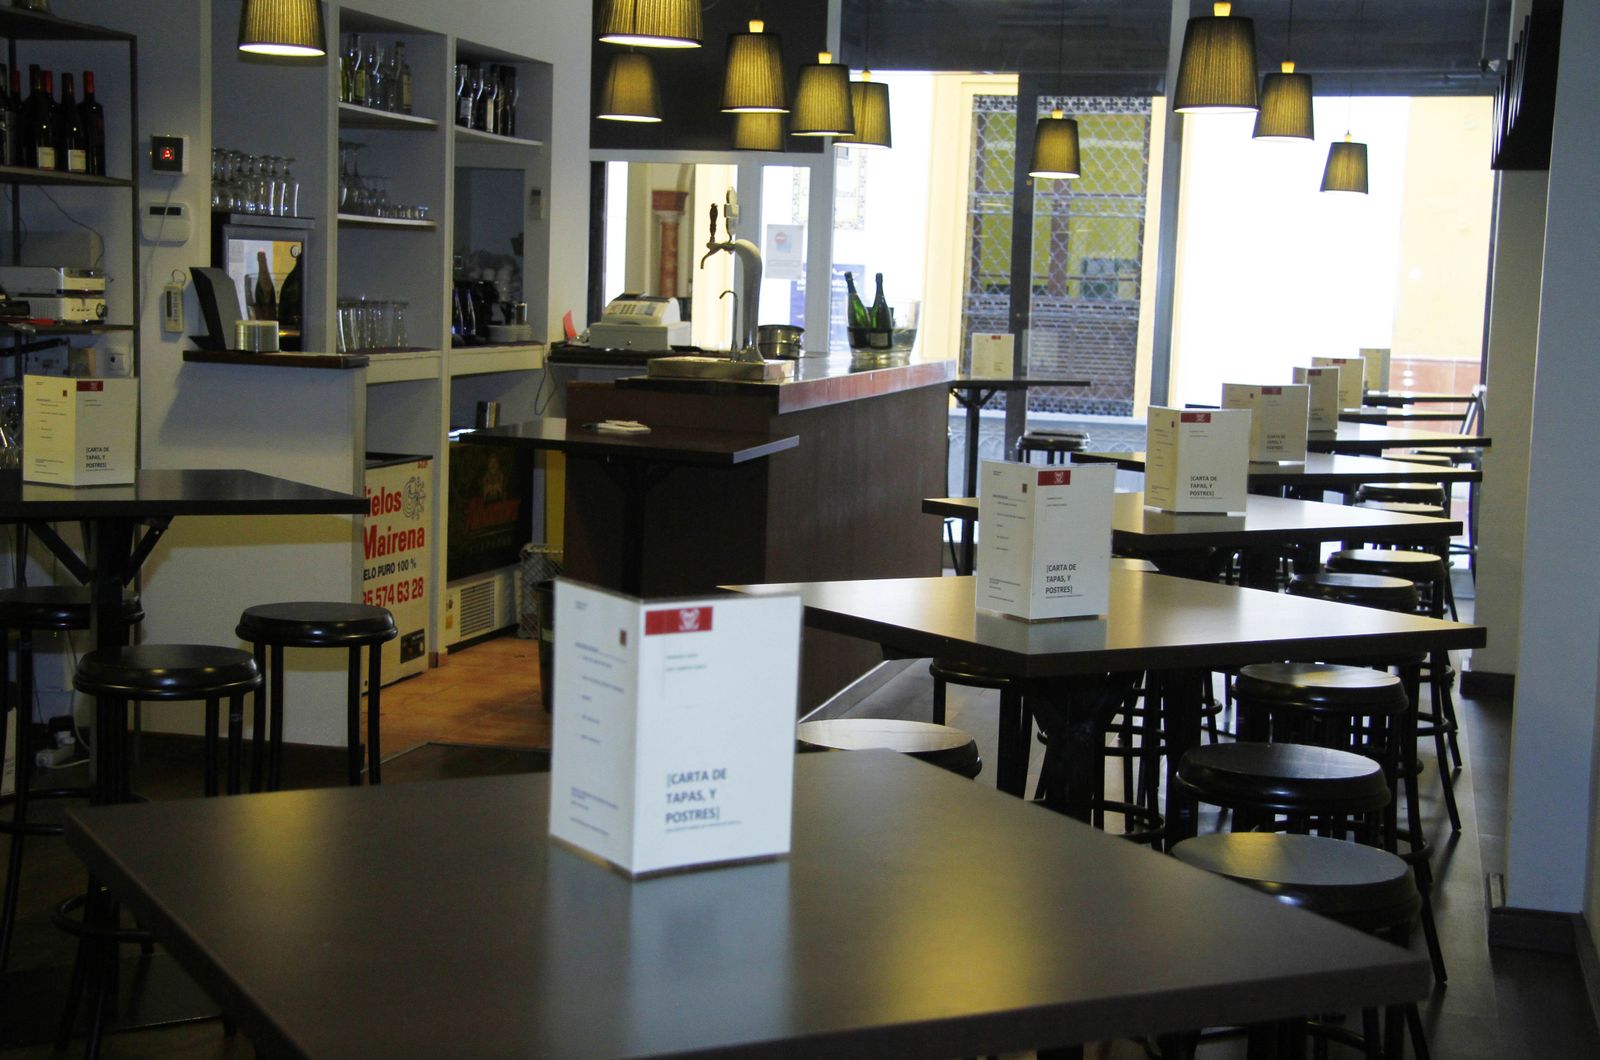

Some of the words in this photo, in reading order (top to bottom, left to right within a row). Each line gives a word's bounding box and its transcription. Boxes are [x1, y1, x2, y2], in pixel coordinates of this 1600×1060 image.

[363, 525, 425, 561] Mairena
[363, 567, 376, 580] ELO
[378, 562, 395, 578] PURO
[397, 559, 409, 572] 100
[410, 557, 417, 569] %
[1068, 563, 1077, 571] DE
[376, 584, 394, 607] 574
[397, 580, 409, 603] 63
[411, 576, 424, 599] 28
[712, 768, 728, 780] DE
[709, 788, 717, 799] Y
